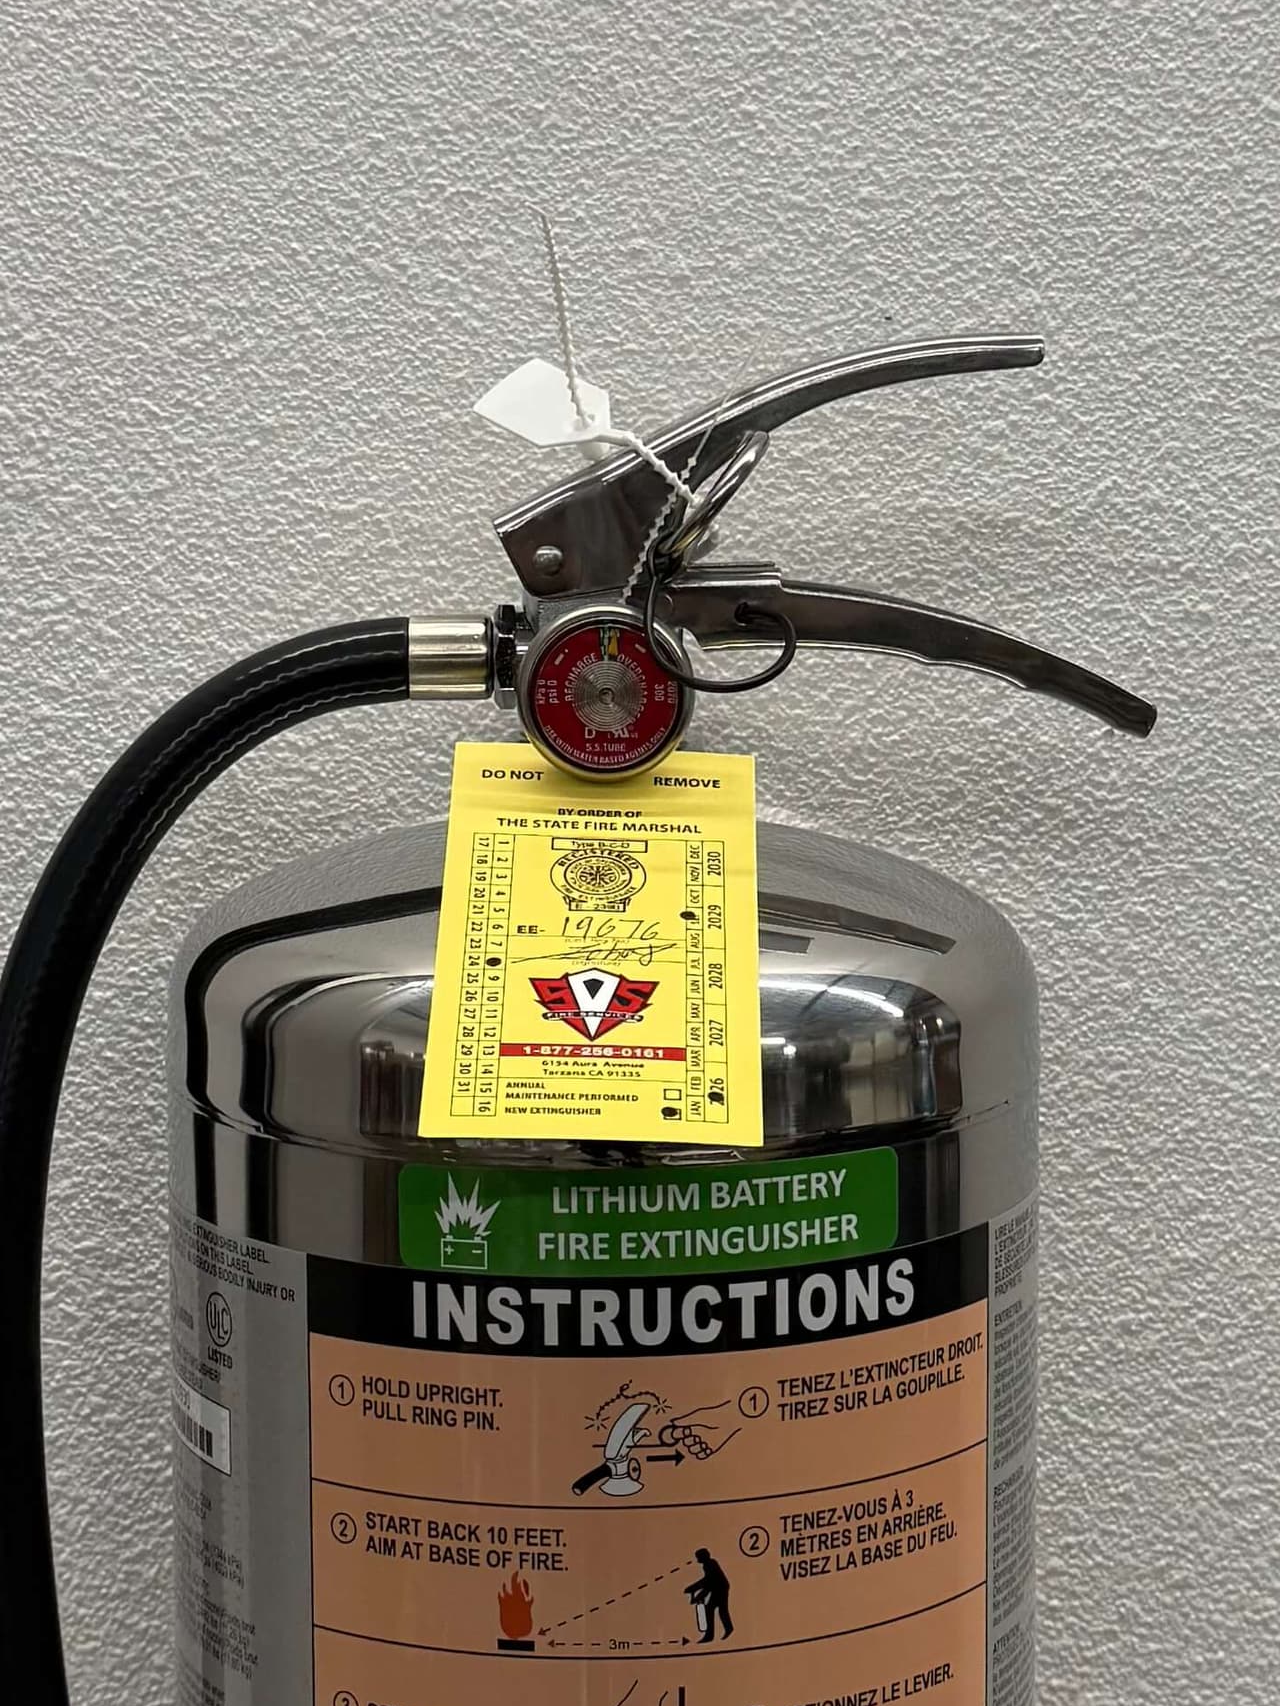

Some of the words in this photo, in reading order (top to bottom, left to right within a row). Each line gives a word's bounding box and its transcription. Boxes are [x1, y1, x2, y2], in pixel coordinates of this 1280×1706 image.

[482, 769, 506, 779] DO
[510, 770, 545, 781] NOT
[653, 777, 721, 789] REMOVE
[497, 818, 528, 828] THE
[532, 819, 580, 830] STATE
[584, 822, 618, 832] FIRE
[622, 823, 702, 834] MARSHAL
[557, 807, 575, 816] BY
[578, 808, 621, 818] ORDER
[623, 810, 642, 818] OF
[707, 850, 721, 876] 2030
[517, 925, 545, 935] EE-
[707, 904, 722, 930] 2029
[708, 962, 723, 990] 2028
[709, 1019, 724, 1047] 2027
[505, 1092, 577, 1101] MAINTENANCE
[579, 1094, 639, 1102] PERFORMED
[506, 1081, 545, 1089] ANNUAL
[504, 1106, 527, 1114] NEW
[530, 1107, 601, 1115] EXTINGUISHER
[553, 1183, 700, 1214] LITHIUM
[711, 1168, 846, 1209] BATTERY
[539, 1233, 610, 1260] FIRE
[621, 1214, 859, 1259] EXTINGUISHER
[246, 1277, 278, 1299] INJURY
[280, 1286, 296, 1302] OR
[412, 1257, 916, 1347] INSTRUCTIONS
[777, 1373, 836, 1398] TENEZ
[839, 1346, 945, 1389] L'EXTINCTEUR
[948, 1332, 983, 1362] DROIT.
[362, 1375, 410, 1398] HOLD
[416, 1382, 503, 1407] UPRIGHT.
[777, 1397, 829, 1421] TIREZ
[833, 1390, 868, 1412] SUR
[872, 1385, 893, 1405] LA
[896, 1363, 966, 1399] GOUPILLE.
[363, 1398, 407, 1422] PULL
[412, 1406, 457, 1427] RING
[464, 1411, 500, 1431] PIN.
[779, 1496, 888, 1533] TENEZ-VOUS
[905, 1489, 914, 1507] 3
[366, 1511, 422, 1537] START
[428, 1520, 481, 1543] BACK
[487, 1526, 507, 1545] 10
[514, 1528, 567, 1547] FEET.
[780, 1528, 852, 1558] MÈTRES
[856, 1524, 878, 1544] EN
[366, 1535, 396, 1557] AIM
[400, 1541, 424, 1560] AT
[429, 1544, 480, 1567] BASE
[486, 1550, 513, 1569] OF
[519, 1552, 568, 1571] FIRE.
[780, 1556, 831, 1581] VISEZ
[836, 1549, 858, 1572] LA
[861, 1538, 903, 1566] BASE
[907, 1529, 927, 1553] DU
[930, 1519, 958, 1546] FEU.
[608, 1639, 631, 1651] 3m
[882, 1681, 900, 1704] LE
[905, 1663, 954, 1697] LEVIER.
